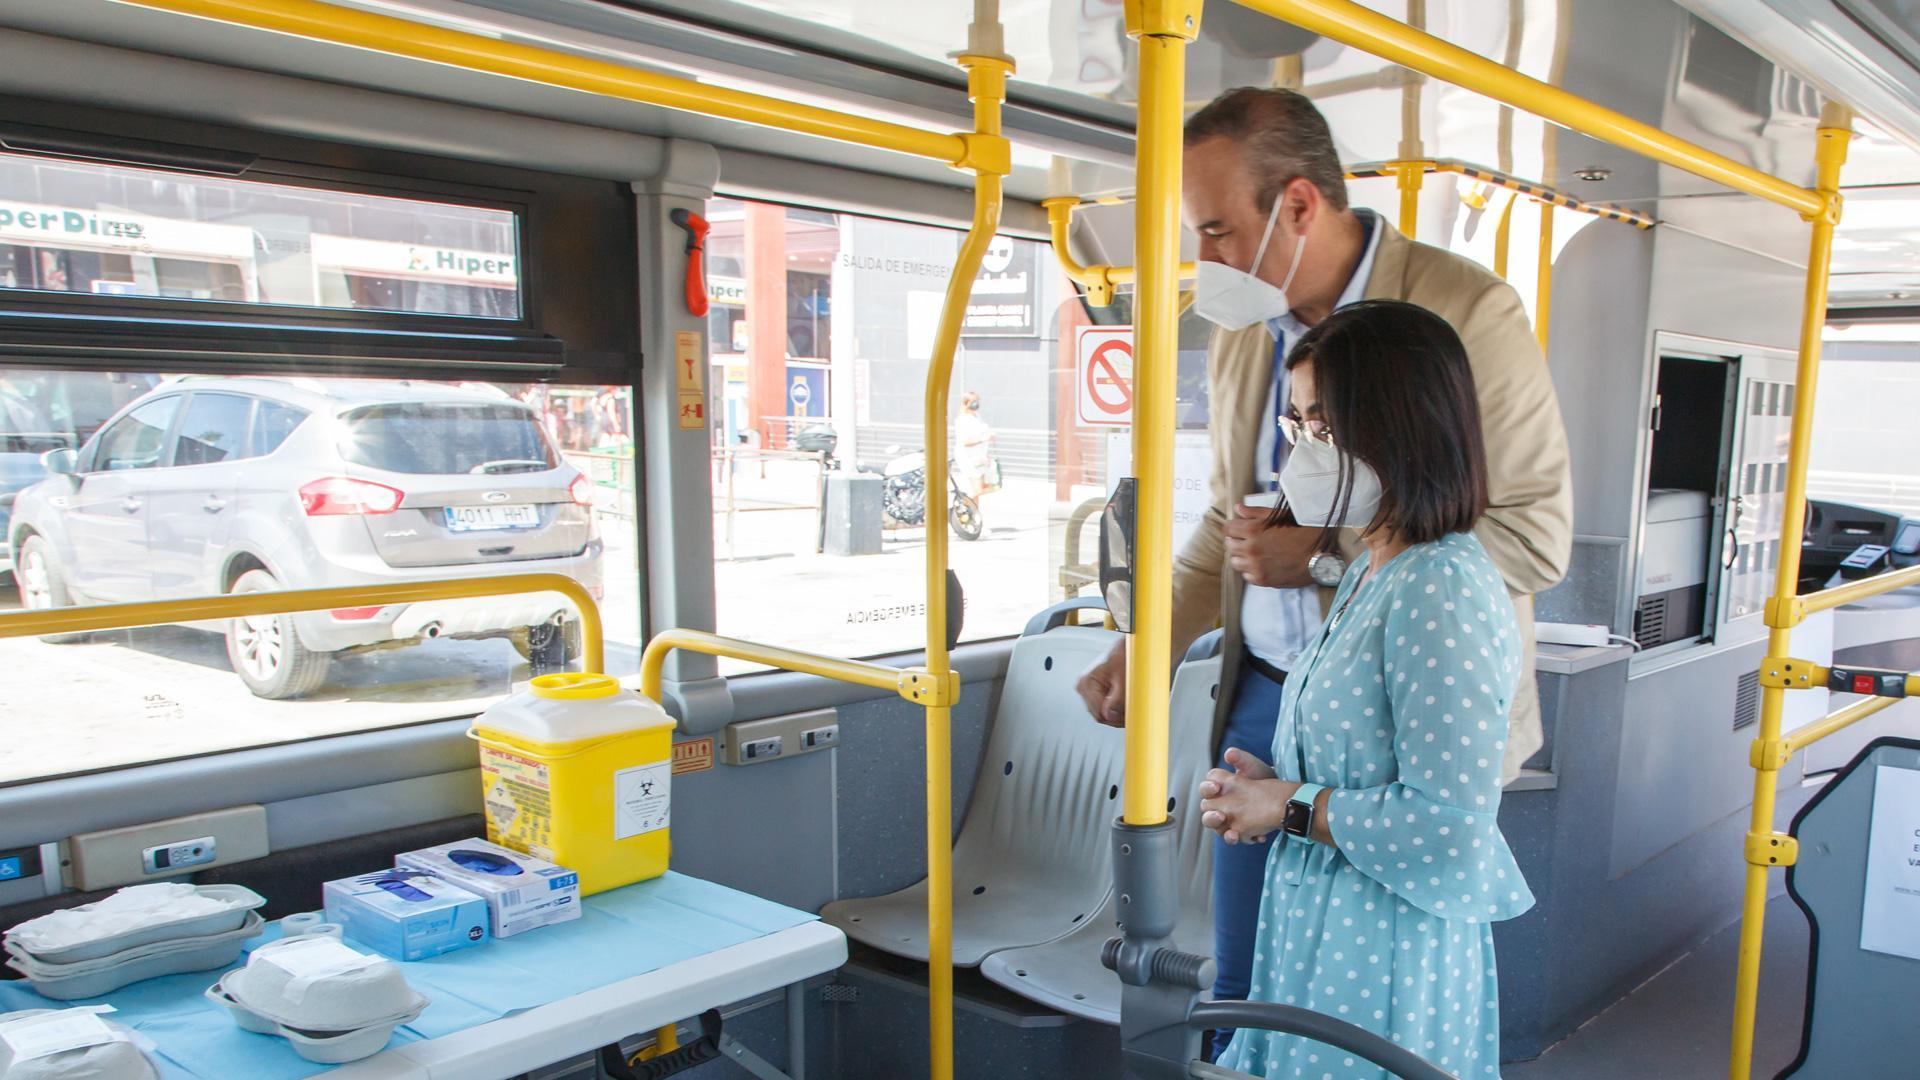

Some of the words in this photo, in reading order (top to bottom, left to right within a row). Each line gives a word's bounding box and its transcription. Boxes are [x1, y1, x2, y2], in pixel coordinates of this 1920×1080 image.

[436, 250, 516, 275] Hiper
[843, 254, 883, 271] SALIDA
[885, 259, 900, 273] DE
[903, 261, 951, 278] EMERGE
[710, 285, 743, 299] iper
[1185, 478, 1201, 491] DE
